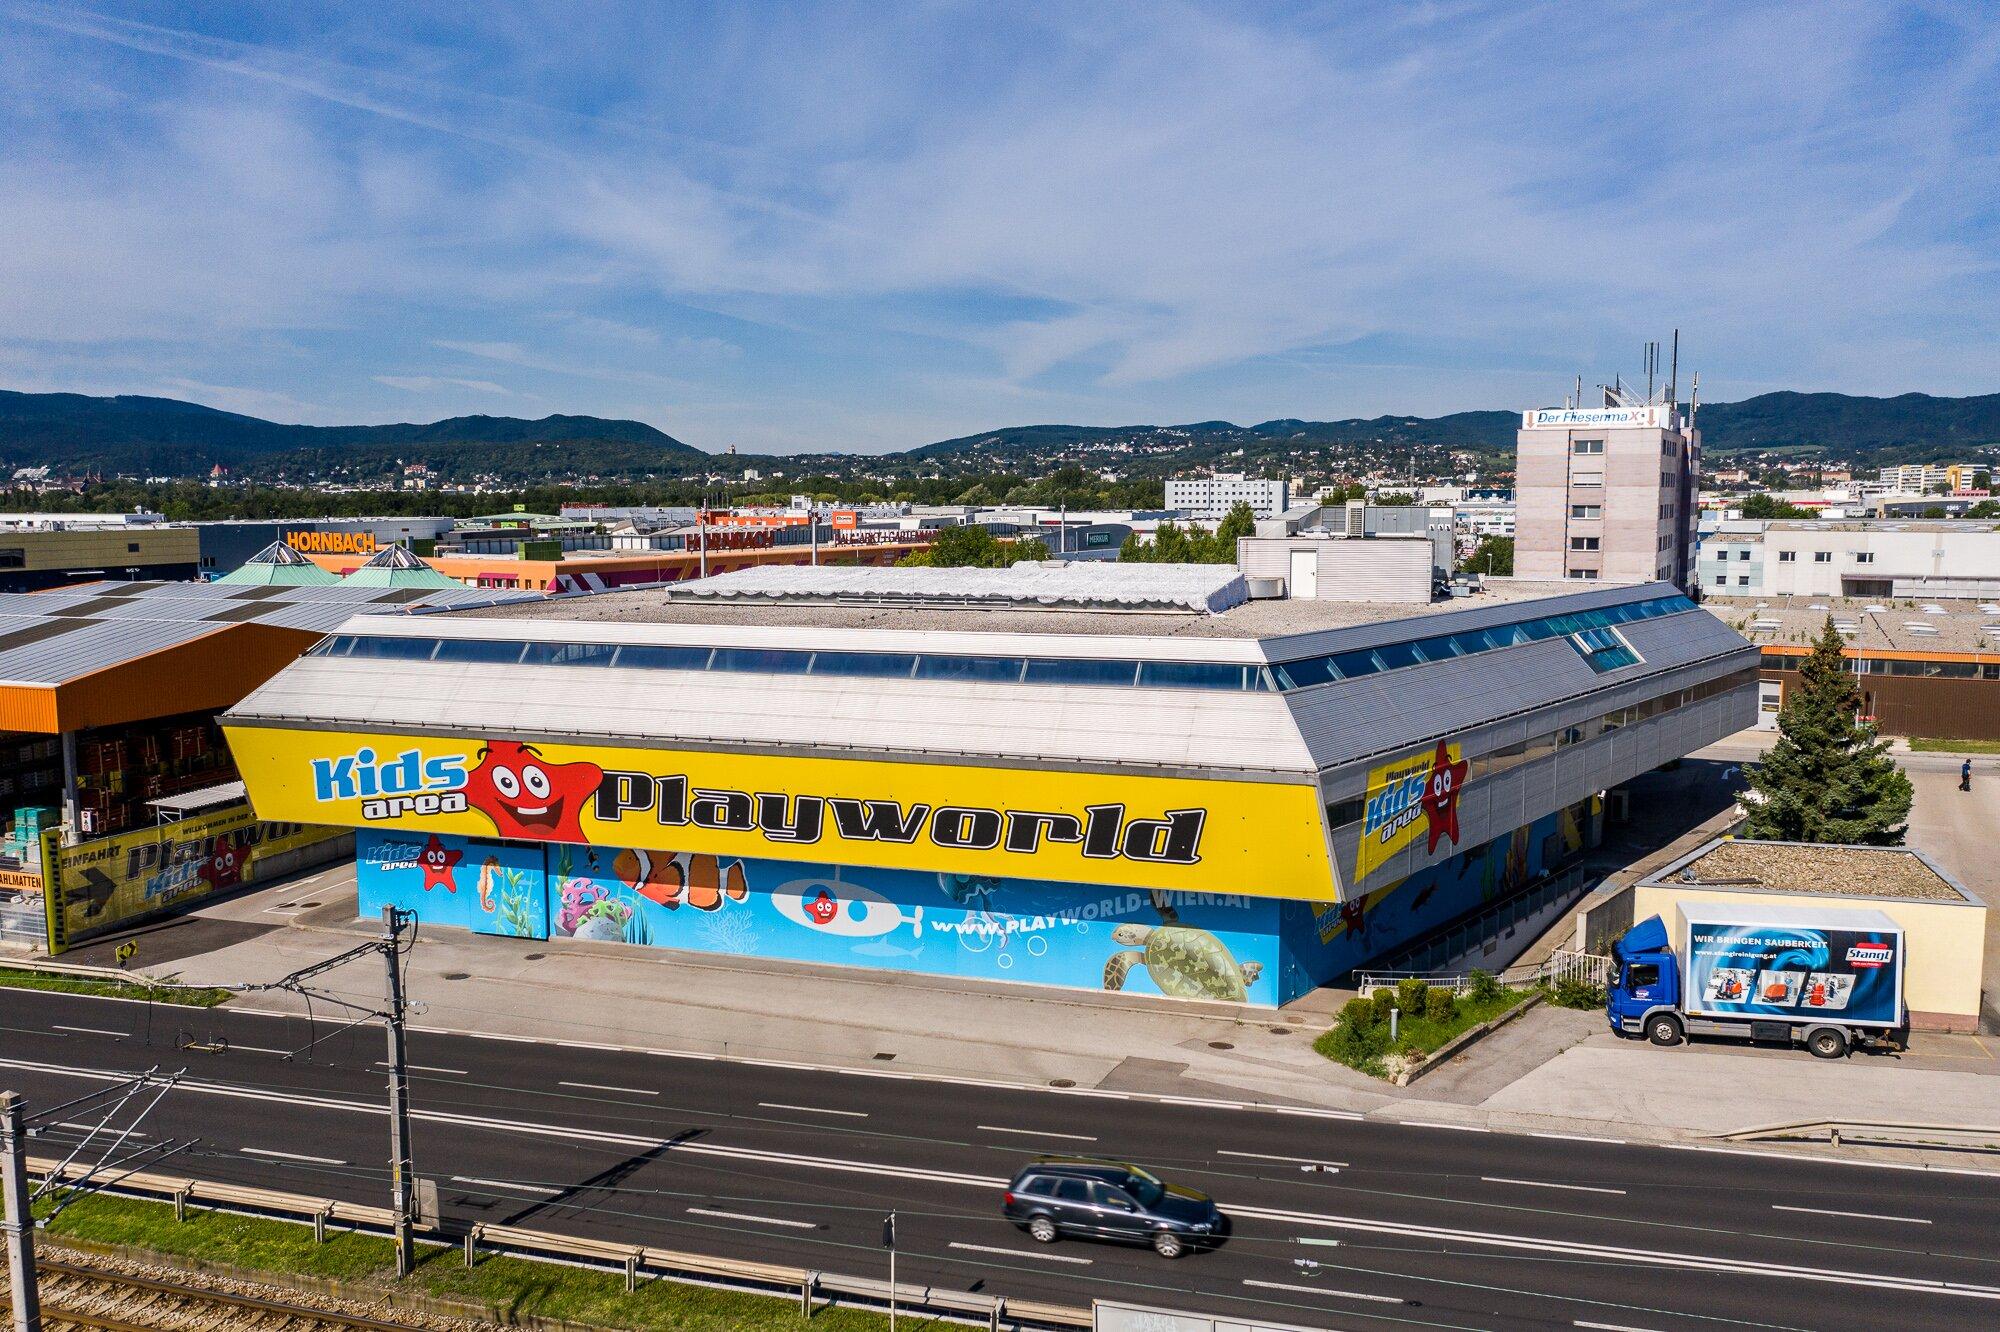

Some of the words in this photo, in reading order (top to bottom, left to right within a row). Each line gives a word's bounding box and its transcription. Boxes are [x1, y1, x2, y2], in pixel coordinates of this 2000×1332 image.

[1537, 412, 1561, 423] Der
[287, 531, 376, 553] HORNBACH
[310, 747, 469, 802] Kids
[1386, 760, 1430, 783] Playworld
[361, 791, 470, 820] area
[594, 769, 1207, 864] Playworld
[1365, 773, 1427, 838] Kids
[182, 820, 227, 835] WILLKOMMEN
[228, 816, 236, 824] IN
[236, 813, 249, 821] DER
[1381, 802, 1422, 844] area
[62, 845, 122, 869] EINFAHRT
[366, 843, 422, 864] Kids
[381, 860, 418, 871] area
[0, 874, 42, 888] AHLMATTEN
[1694, 935, 1714, 944] WIR
[1716, 936, 1762, 946] BRINGEN
[1764, 938, 1828, 949] SAUBERKEIT
[1849, 949, 1890, 961] Stangl
